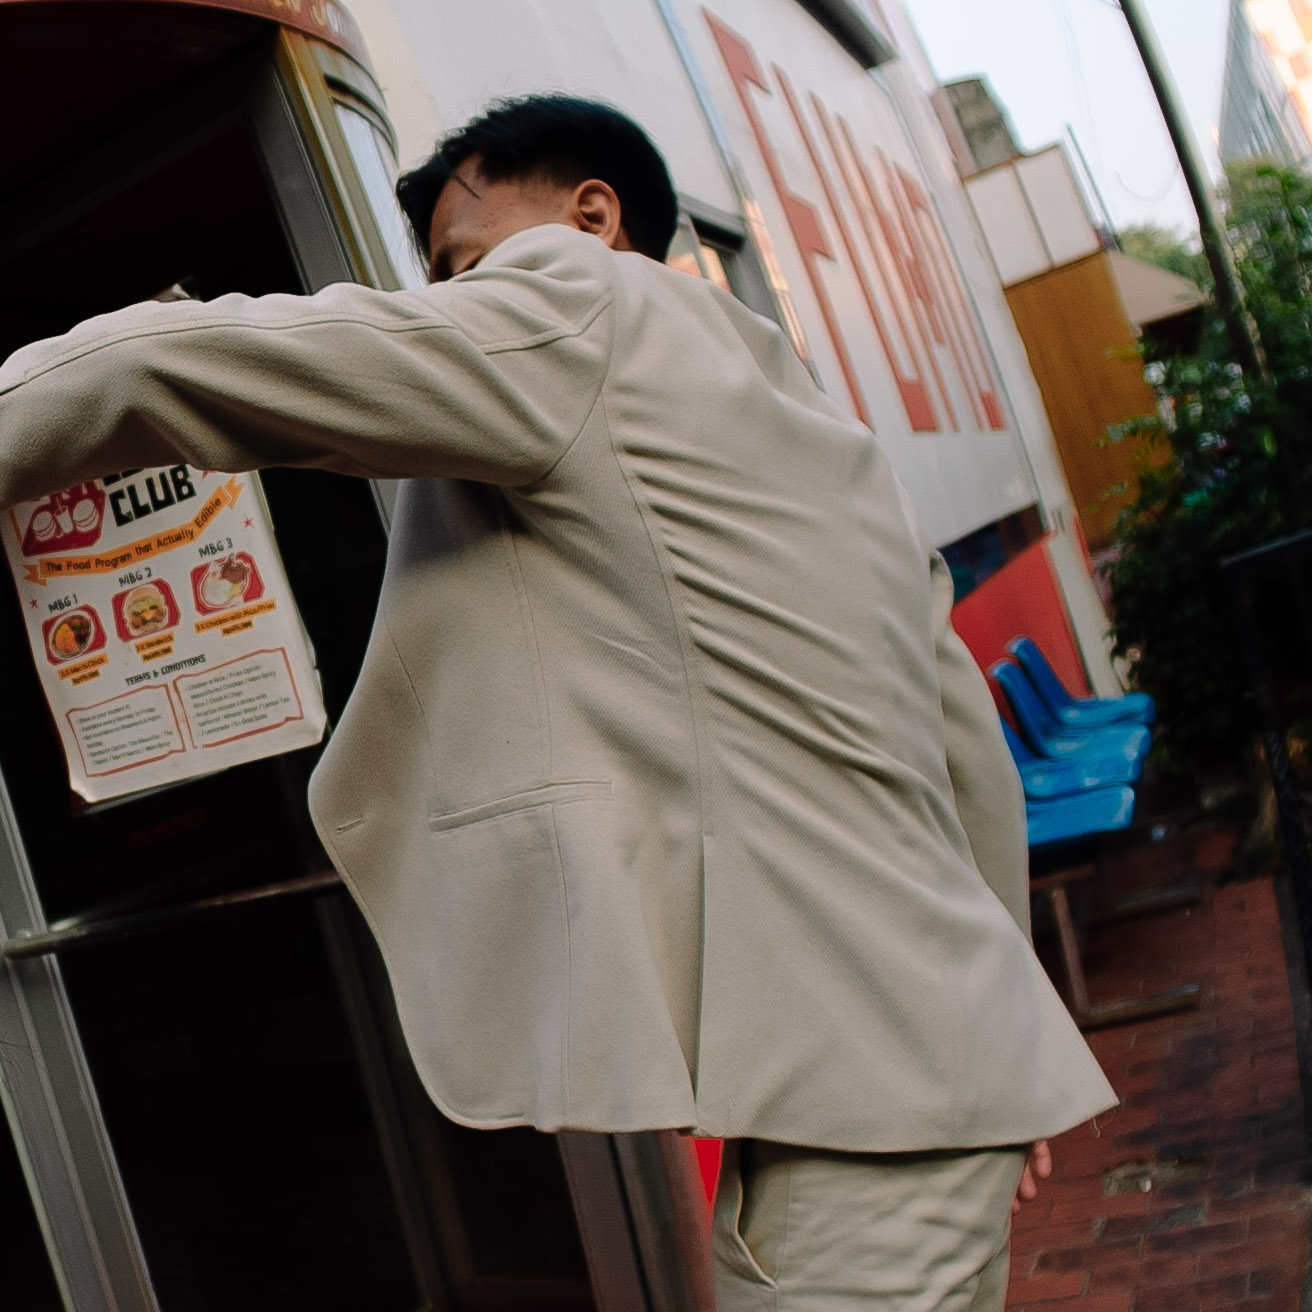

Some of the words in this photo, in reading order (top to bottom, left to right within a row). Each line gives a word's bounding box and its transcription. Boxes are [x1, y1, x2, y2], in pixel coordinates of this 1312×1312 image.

[108, 463, 198, 528] CLUB
[46, 561, 63, 572] The
[66, 559, 91, 571] Food
[94, 550, 133, 569] Program
[194, 496, 222, 529] Edible
[198, 540, 225, 558] MBG
[225, 537, 234, 549] 3
[144, 566, 154, 579] 2
